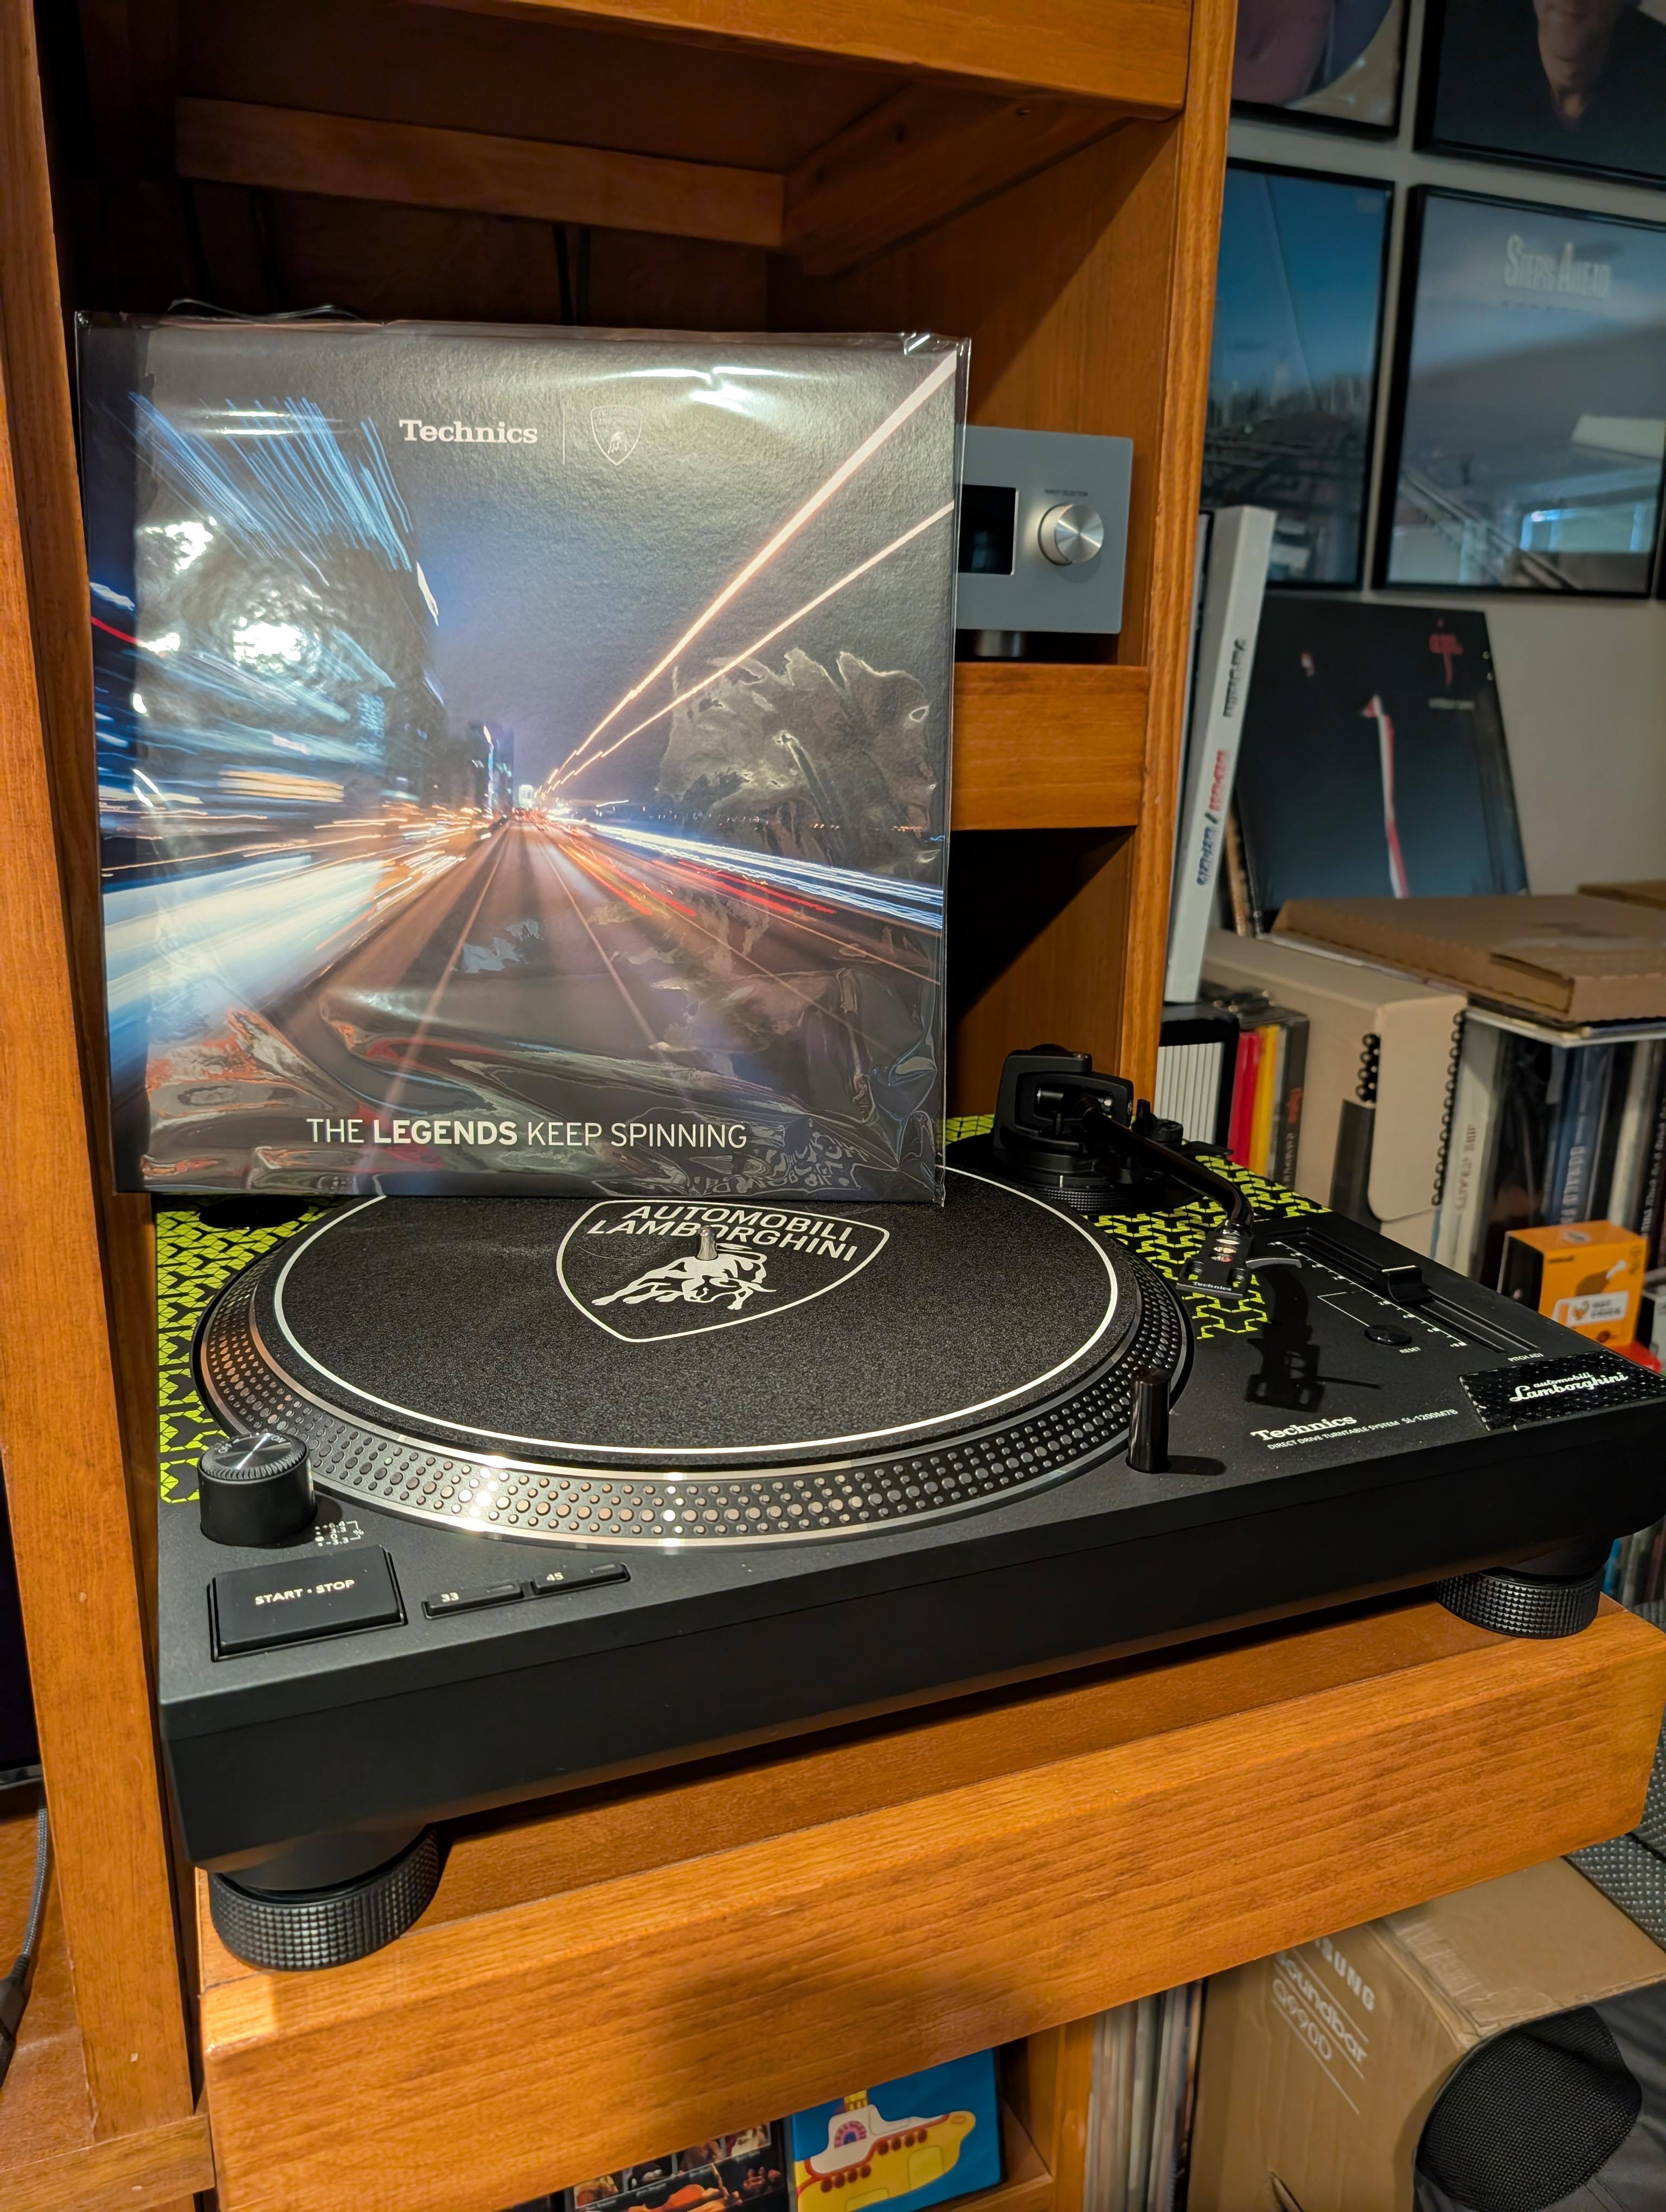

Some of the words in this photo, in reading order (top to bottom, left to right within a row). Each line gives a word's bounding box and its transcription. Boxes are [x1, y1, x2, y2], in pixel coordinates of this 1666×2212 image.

[399, 420, 538, 443] Technics
[306, 1118, 364, 1143] THE
[374, 1120, 518, 1146] LEGENDS
[529, 1121, 603, 1146] KEEP
[611, 1123, 747, 1149] SPINNING
[621, 1205, 853, 1242] AUTOMOBILI
[1192, 1281, 1232, 1291] Technics
[1507, 1354, 1529, 1362] PITCH
[1509, 1372, 1629, 1402] Lamborghini
[1533, 1372, 1593, 1388] automobili
[271, 1435, 287, 1443] ON
[1250, 1416, 1357, 1441] Technics
[1267, 1439, 1298, 1450] DIRECT
[1297, 1435, 1324, 1445] DRIVE
[1322, 1426, 1370, 1439] TURNTABLE
[1368, 1420, 1401, 1431] SYSTEM
[1401, 1409, 1459, 1424] SL-1200M7B
[546, 1571, 565, 1581] 45
[254, 1588, 303, 1606] START
[316, 1579, 355, 1594] STOP
[440, 1591, 460, 1603] 33
[1315, 1937, 1376, 2011] SUNG
